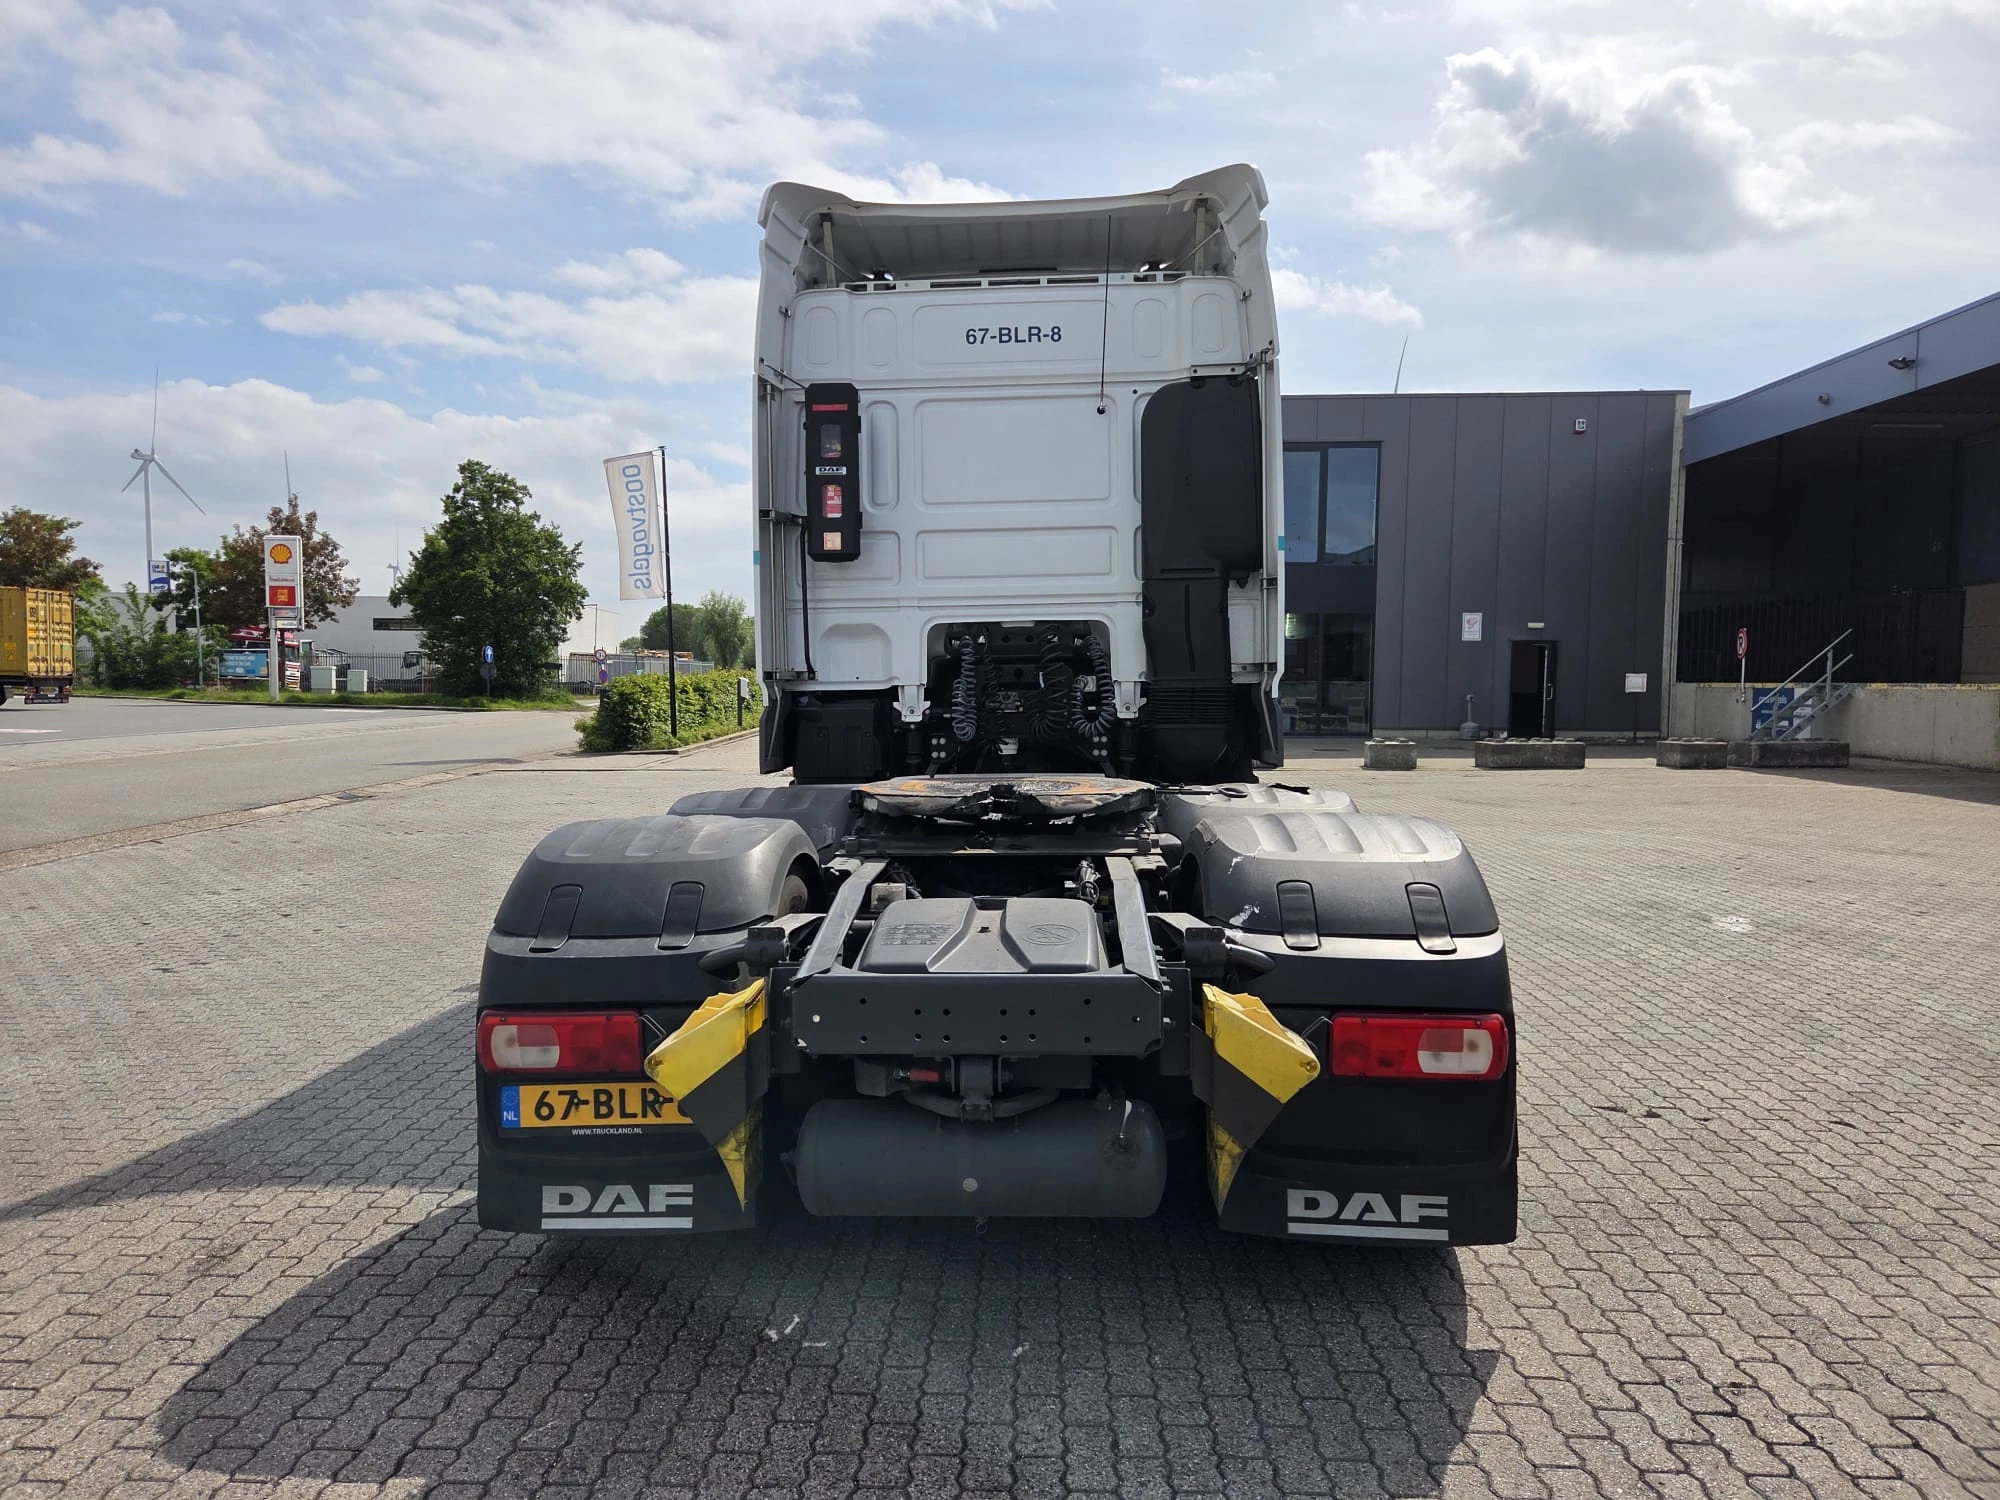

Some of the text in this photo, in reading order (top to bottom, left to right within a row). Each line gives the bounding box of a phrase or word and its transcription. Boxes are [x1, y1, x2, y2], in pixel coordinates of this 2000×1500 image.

[965, 325, 1062, 345] 67-BLR-8
[503, 1111, 518, 1121] NL
[534, 1087, 690, 1122] 67-BLR-
[571, 1127, 644, 1136] WWW.TRUCKLAND.NL
[542, 1184, 693, 1213] DAF
[1287, 1188, 1449, 1223] DAF
